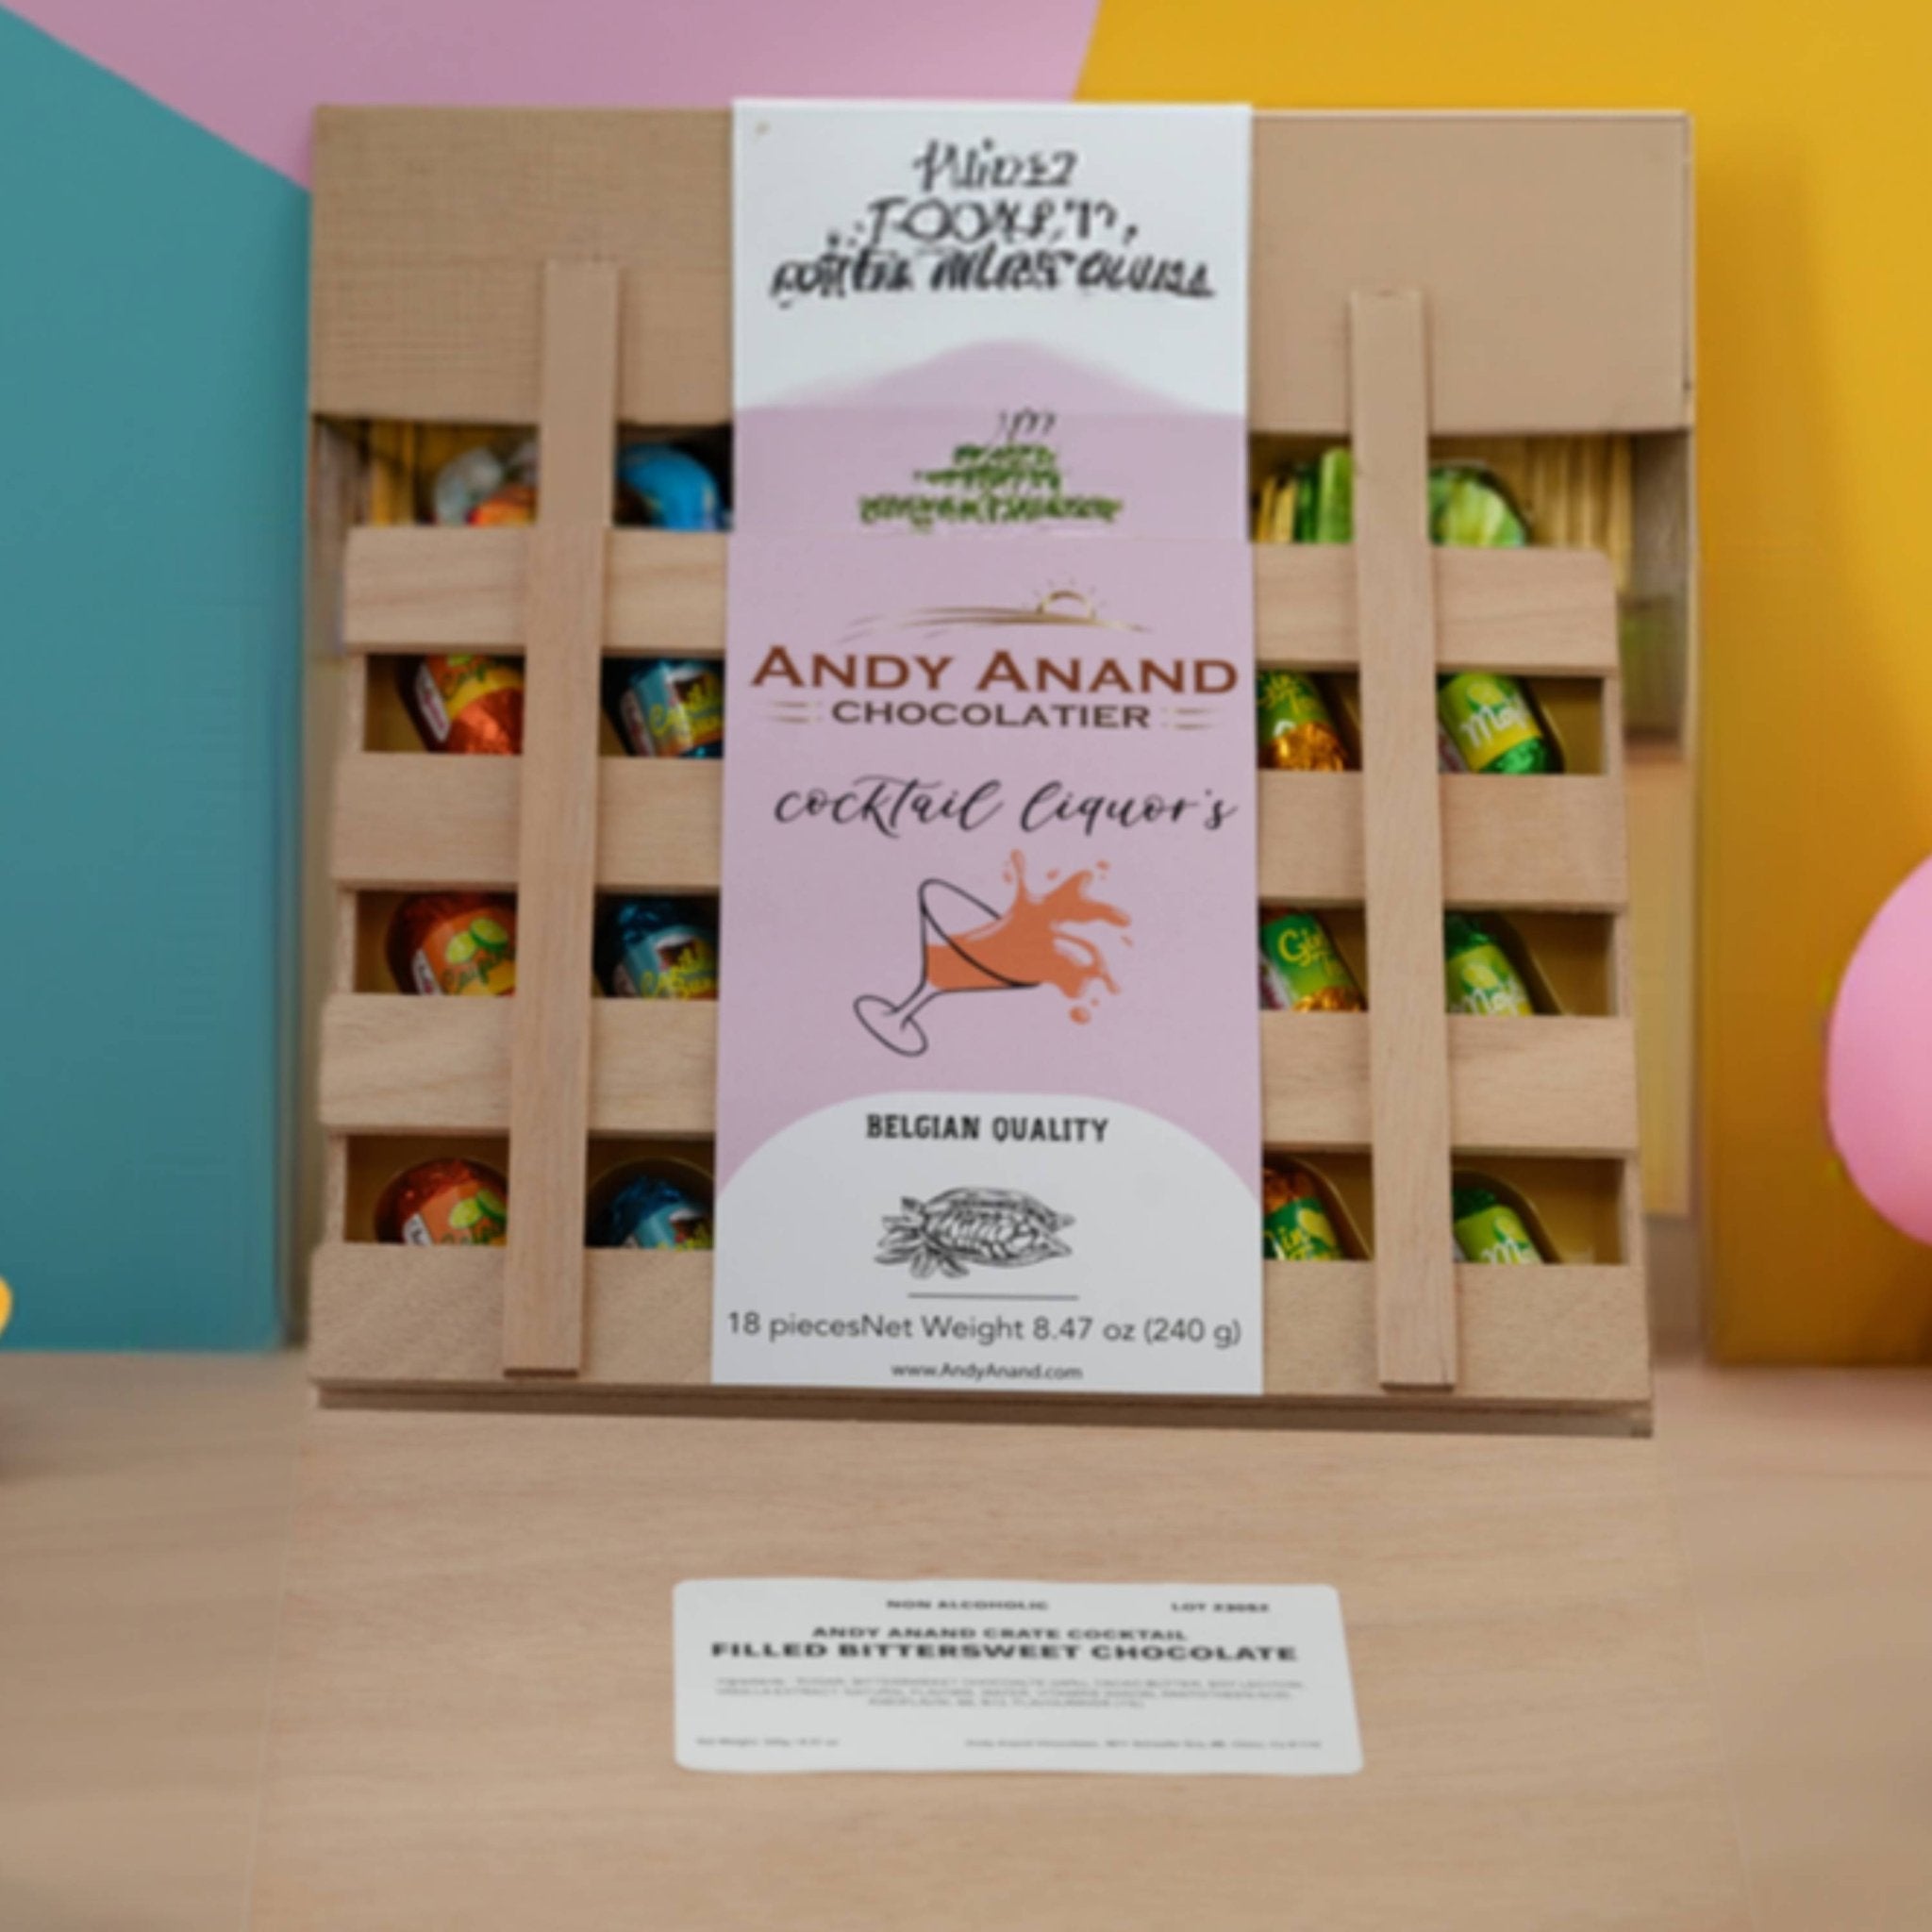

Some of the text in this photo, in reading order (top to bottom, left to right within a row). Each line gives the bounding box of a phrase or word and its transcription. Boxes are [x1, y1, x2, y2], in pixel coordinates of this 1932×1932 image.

[750, 644, 1239, 694] ANDY ANAND
[830, 699, 1151, 729] CHOCOLATIER
[774, 775, 1238, 839] cocktail liquor's
[866, 1113, 1109, 1143] BELGIAN QUALITY
[728, 1310, 761, 1336] 18
[920, 1314, 1024, 1347] Weight
[1032, 1315, 1094, 1341] 8.47
[1102, 1323, 1136, 1342] oz
[1143, 1317, 1207, 1346] (240
[1212, 1319, 1242, 1349] g)
[891, 1360, 1084, 1383] www.AndyAnand.com
[886, 1599, 933, 1611] NON
[937, 1599, 1049, 1611] ALCOHOLIC
[811, 1625, 1188, 1641] ANDY ANAND CRATE COCKTAIL
[710, 1641, 1298, 1662] FILLED BITTERSWEET CHOCOLATE
